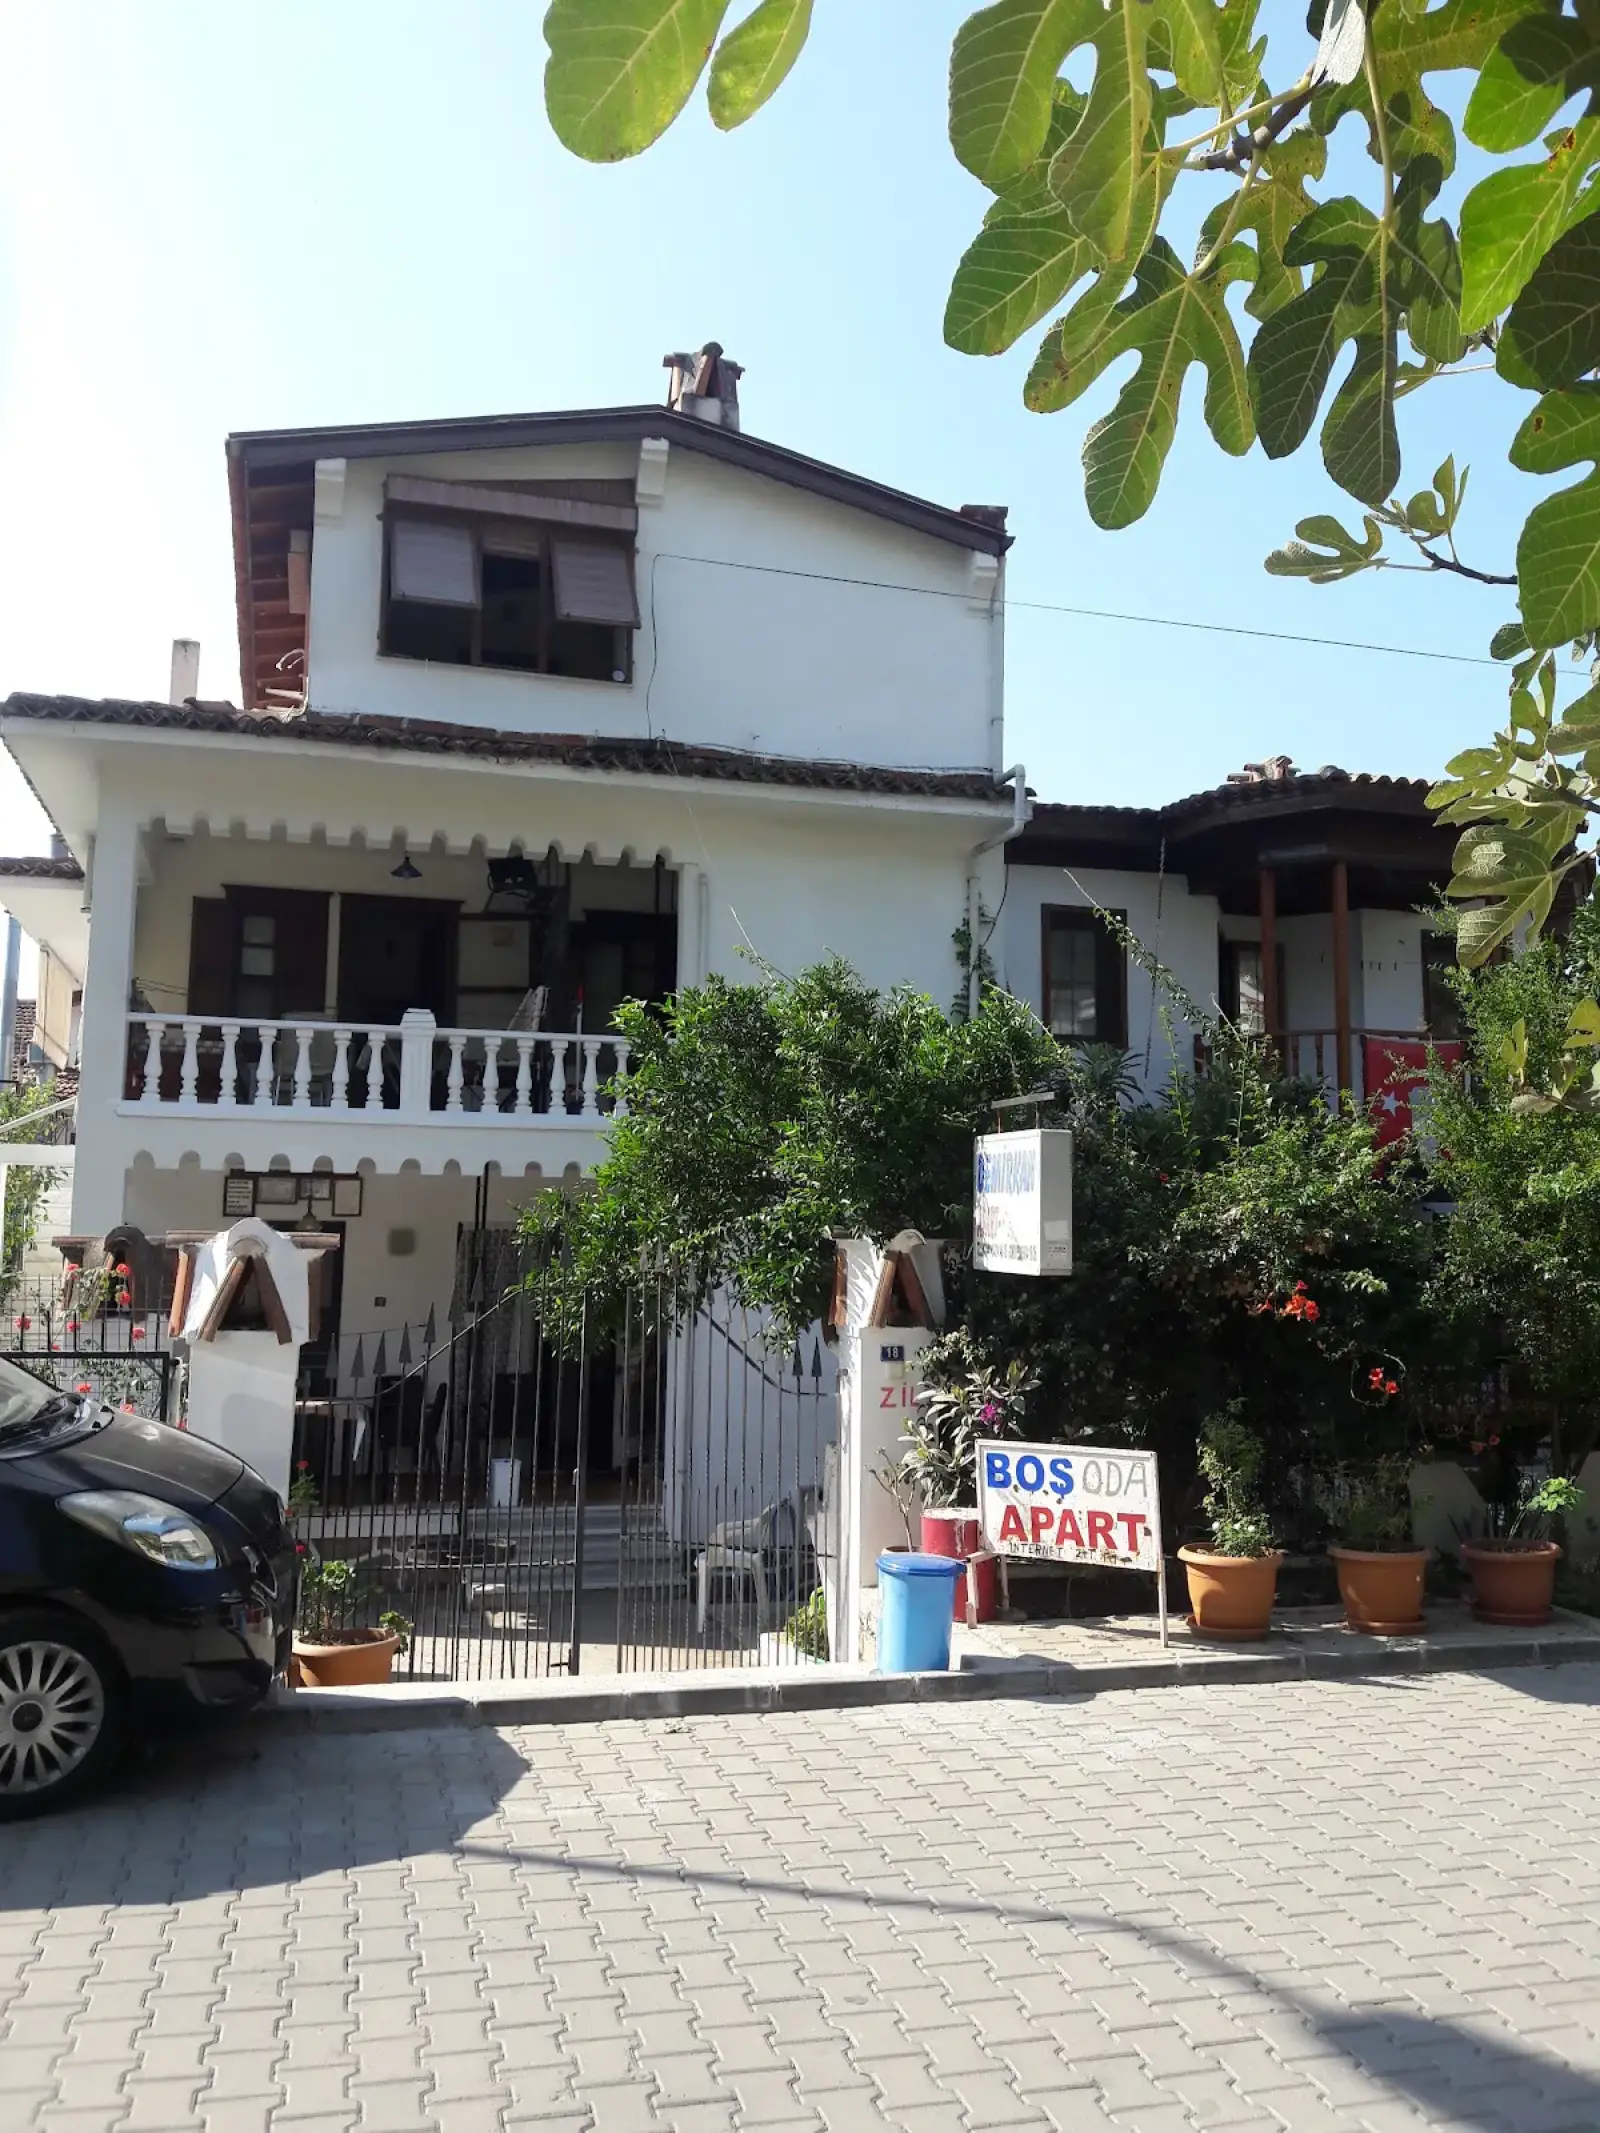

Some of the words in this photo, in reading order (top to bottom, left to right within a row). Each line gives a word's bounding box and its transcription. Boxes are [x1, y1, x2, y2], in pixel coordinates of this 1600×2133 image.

[886, 1347, 898, 1358] 18
[986, 1452, 1074, 1498] BOŞ
[1082, 1460, 1147, 1498] ODA
[999, 1504, 1146, 1554] APART
